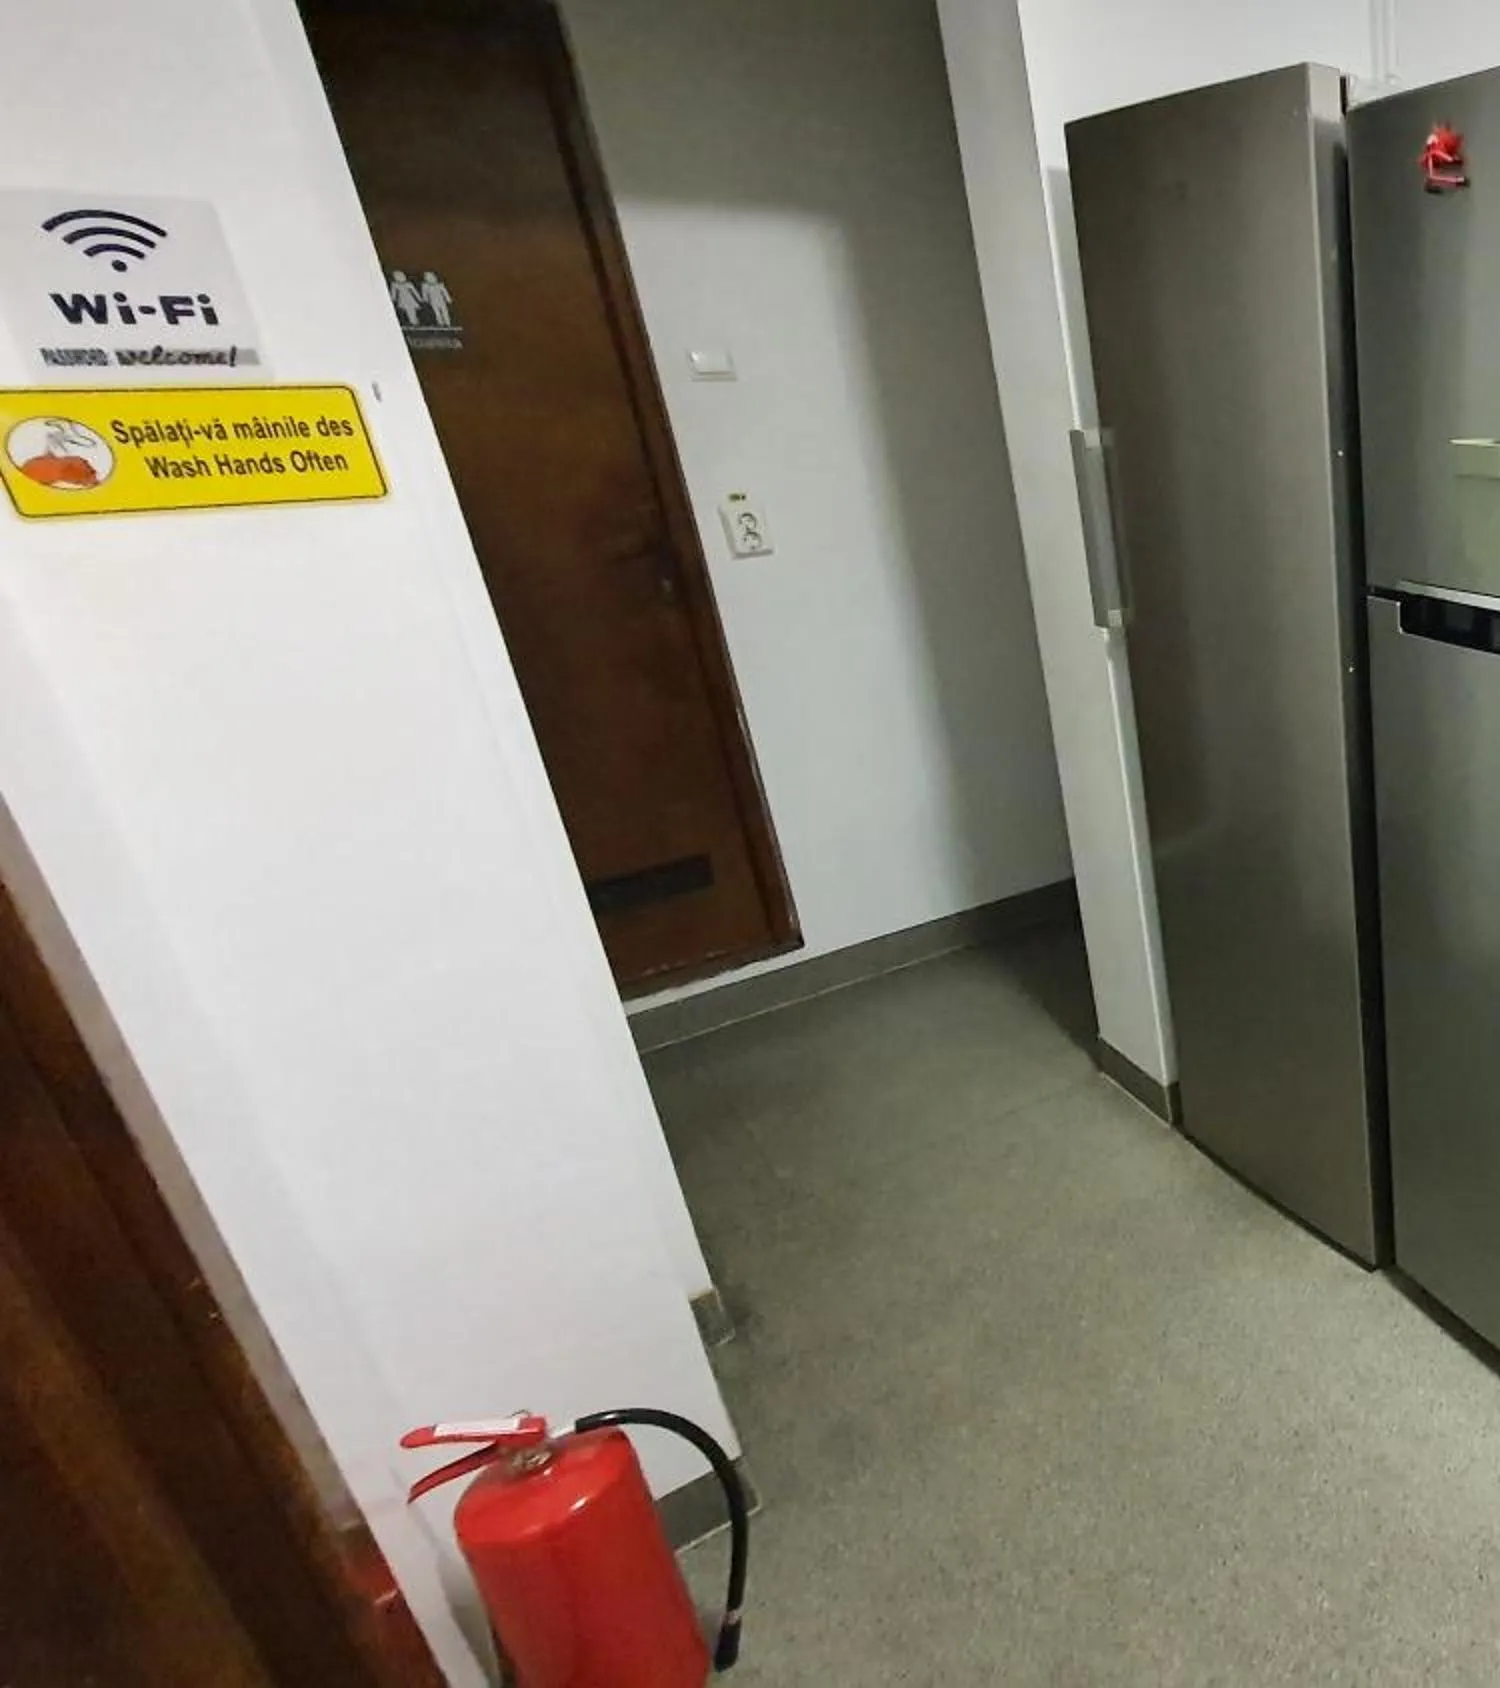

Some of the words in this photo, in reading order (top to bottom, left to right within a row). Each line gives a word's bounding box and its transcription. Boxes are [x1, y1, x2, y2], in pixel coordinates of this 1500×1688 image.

[49, 291, 219, 326] Wi-Fi
[232, 416, 310, 440] mâinile
[315, 416, 354, 437] des
[144, 455, 212, 479] Wash
[213, 452, 286, 476] Hands
[289, 449, 349, 473] Often
